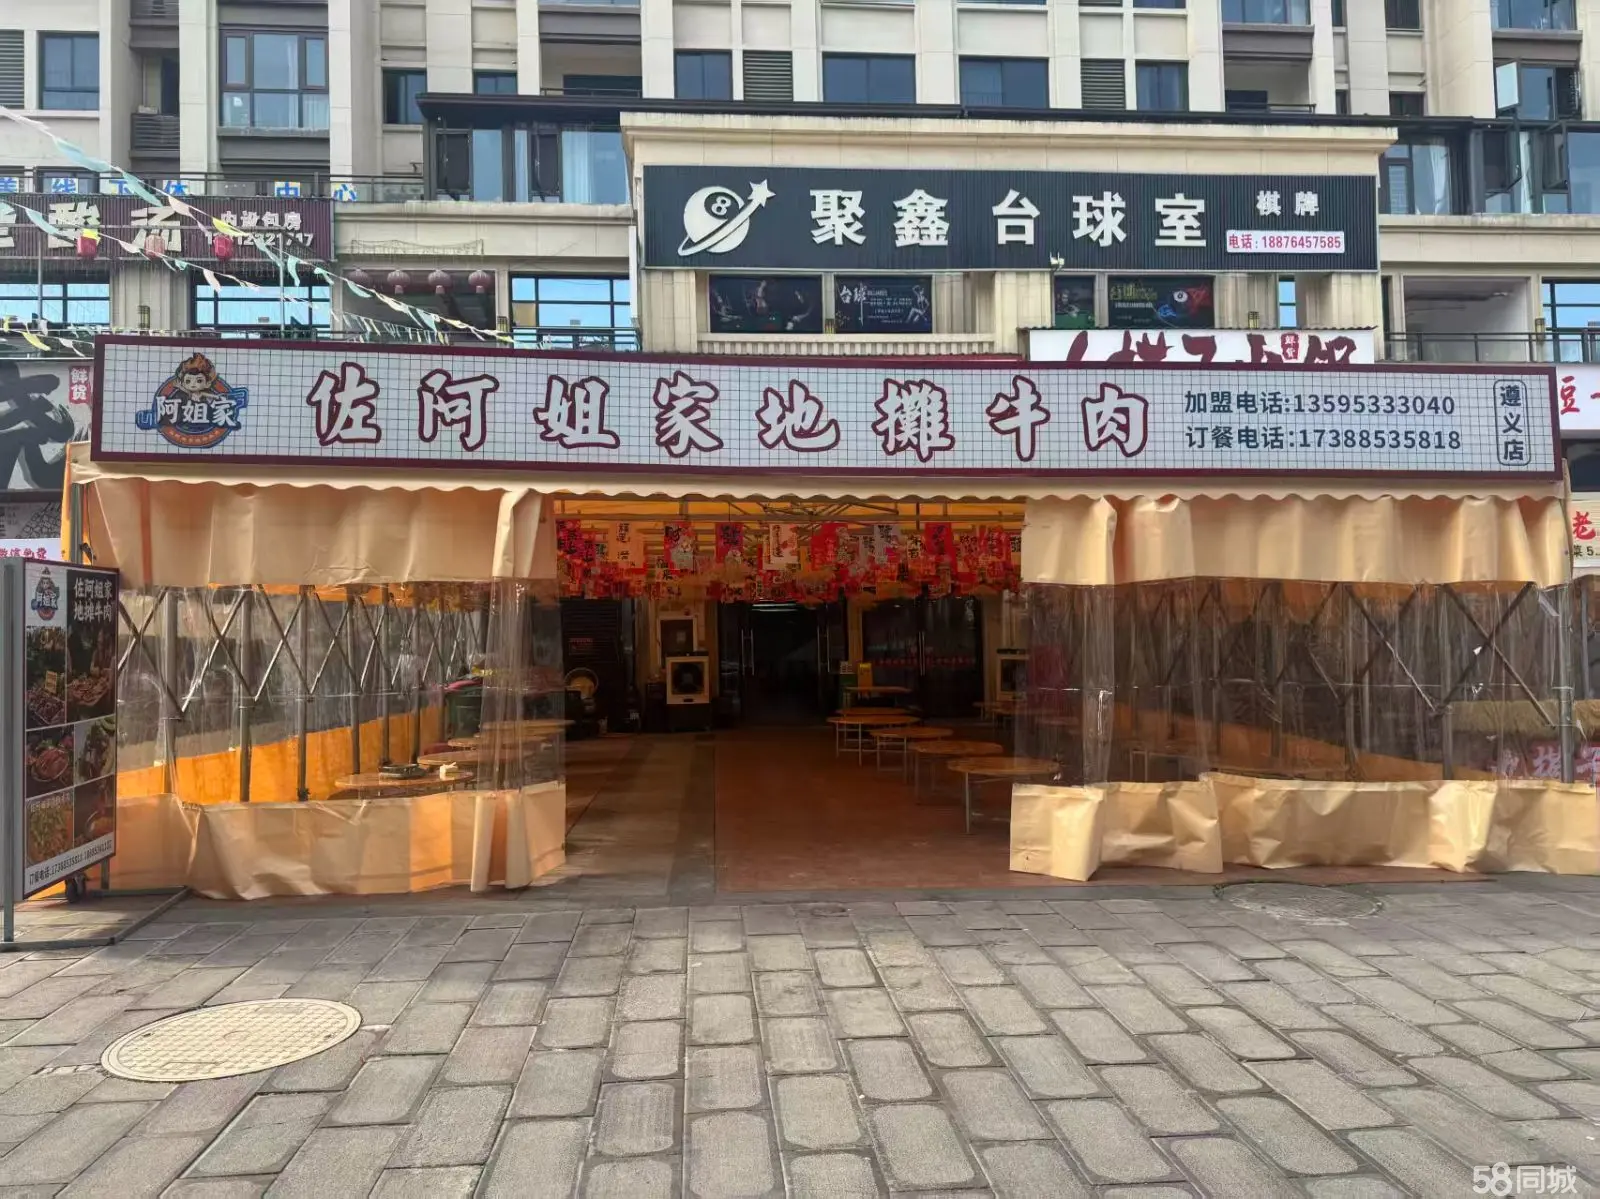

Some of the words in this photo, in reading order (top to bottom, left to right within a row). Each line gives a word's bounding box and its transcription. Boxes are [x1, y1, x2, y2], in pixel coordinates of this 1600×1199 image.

[1256, 190, 1319, 216] 棋牌
[808, 189, 1207, 247] 聚鑫台球室
[1229, 234, 1341, 249] 电话:18876457585
[155, 395, 238, 427] 阿姐家
[1184, 390, 1455, 415] 加盟电话:13595333040
[1499, 385, 1525, 461] 遵义店
[1185, 426, 1461, 450] 订餐电话:17388535818
